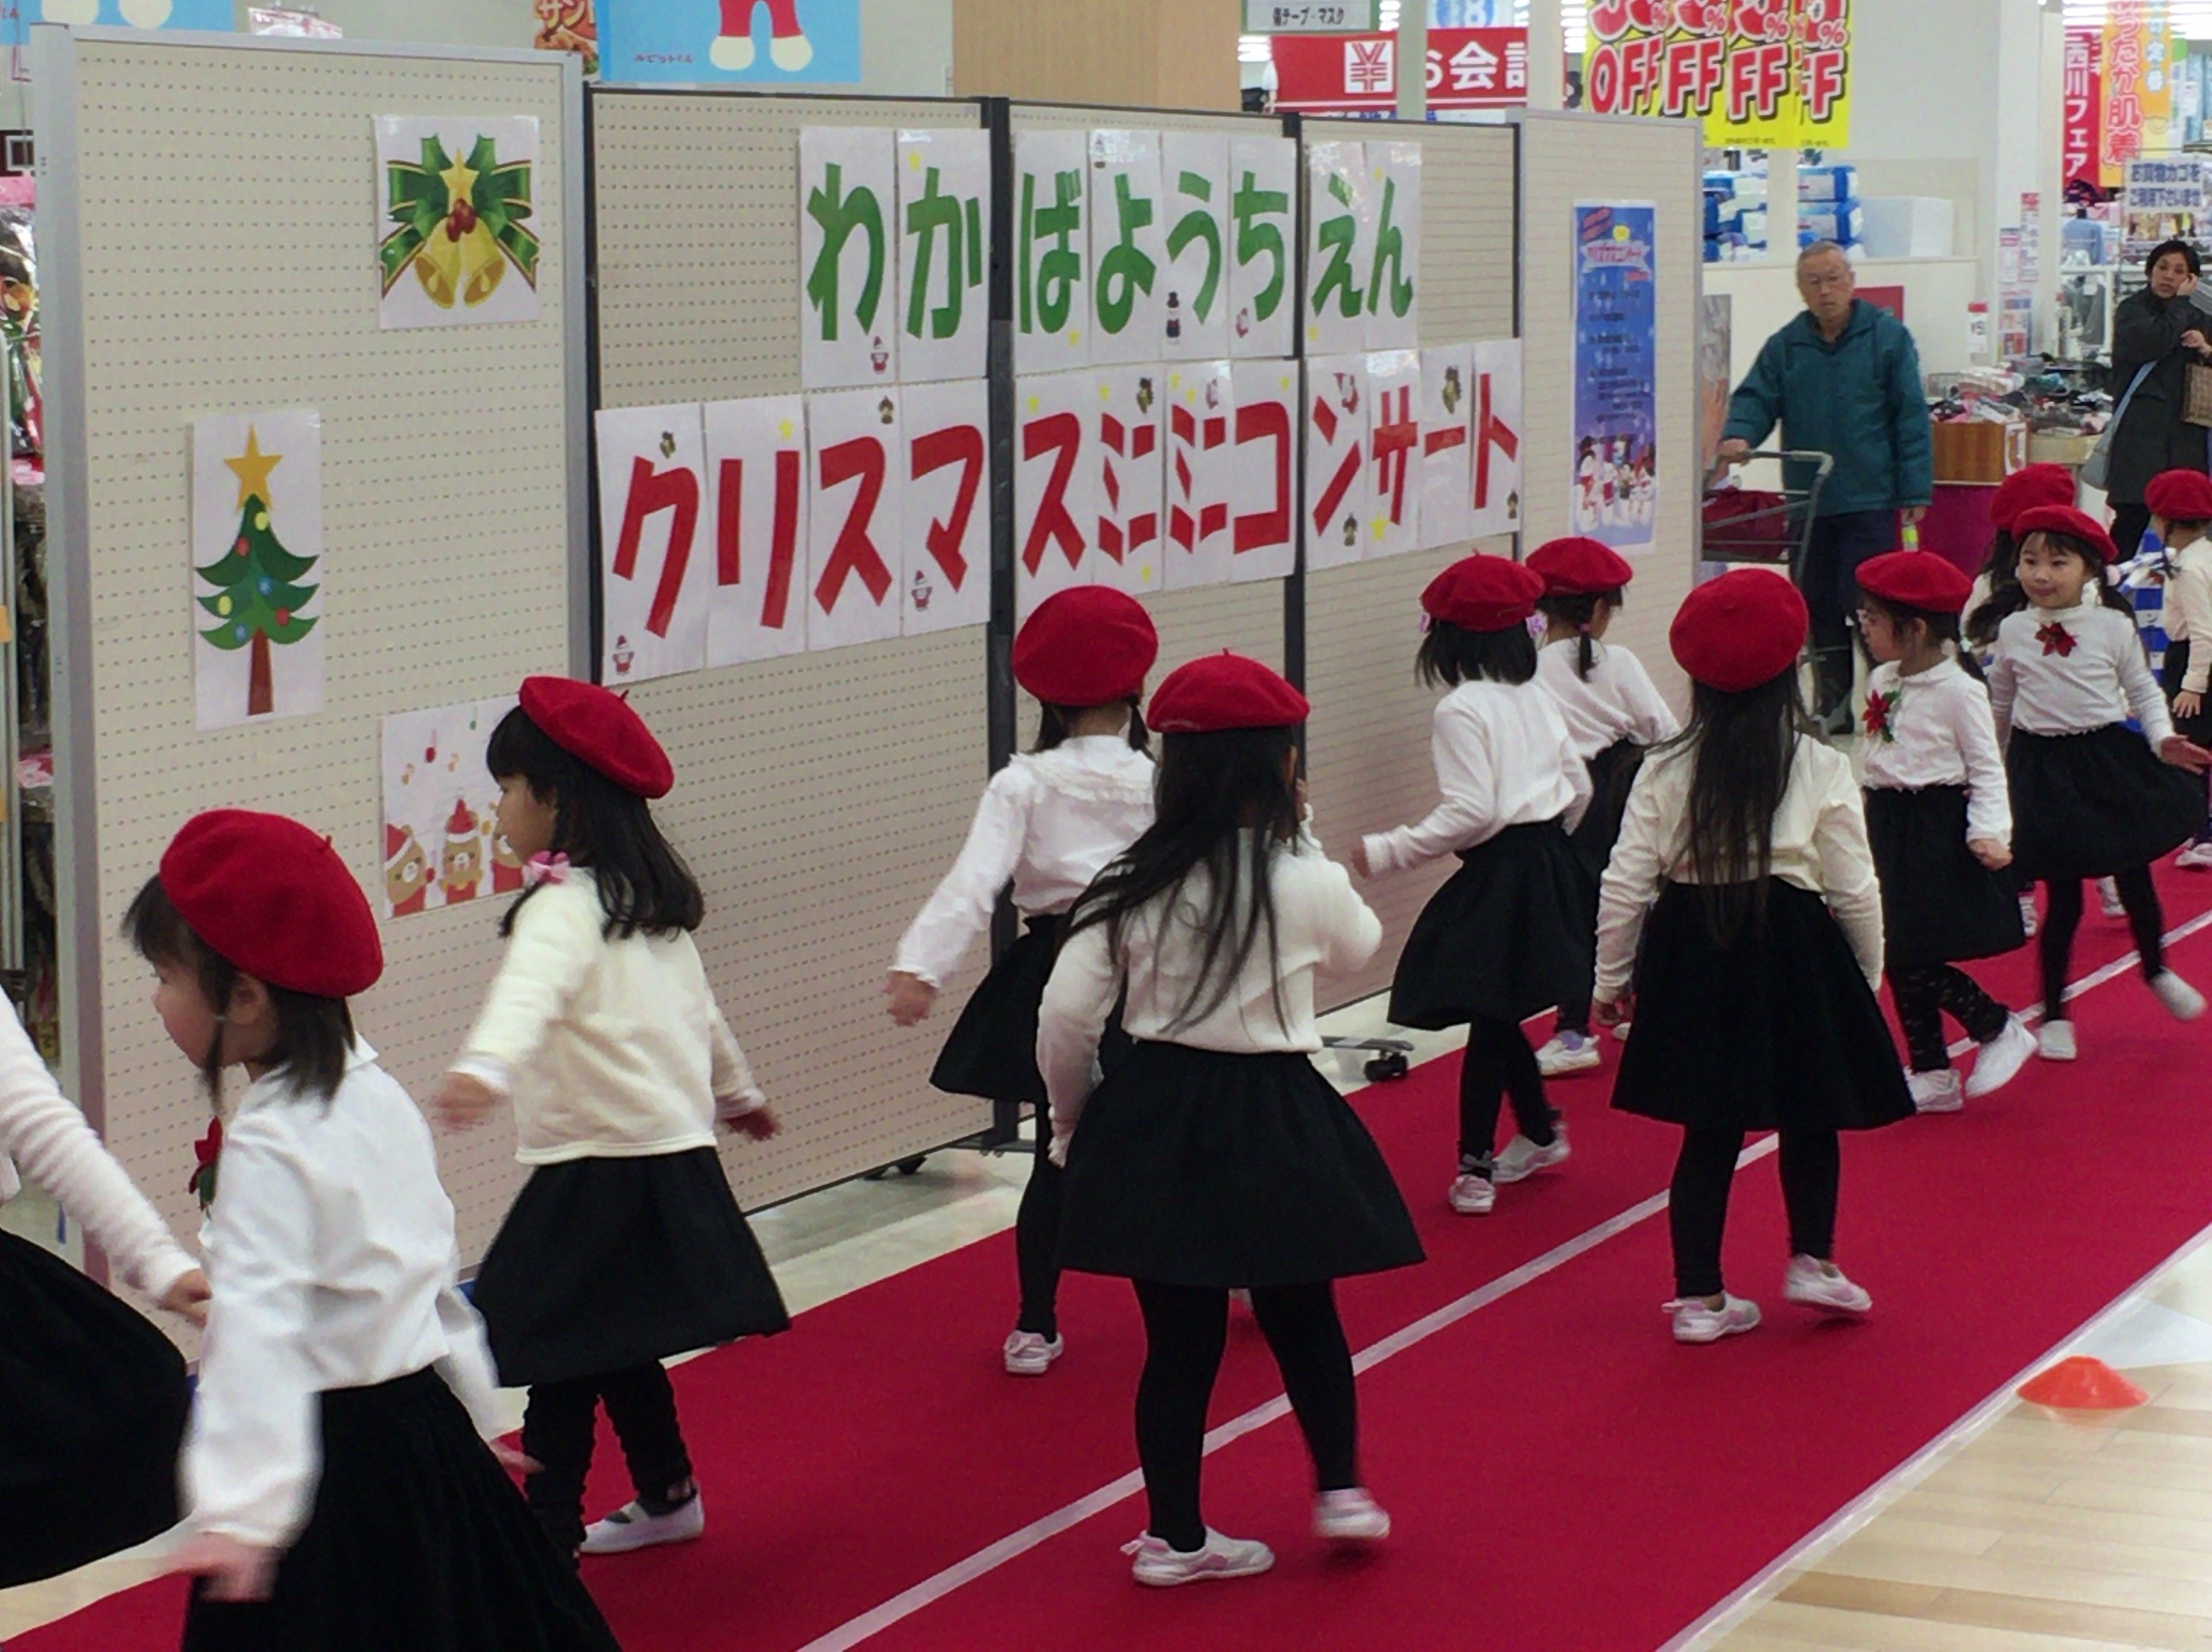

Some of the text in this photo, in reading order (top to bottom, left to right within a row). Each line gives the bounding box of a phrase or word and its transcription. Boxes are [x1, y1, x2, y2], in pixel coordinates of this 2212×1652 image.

[806, 162, 1413, 340] わかばようちえん
[612, 373, 1518, 639] クリスマスミニミニコンサート
